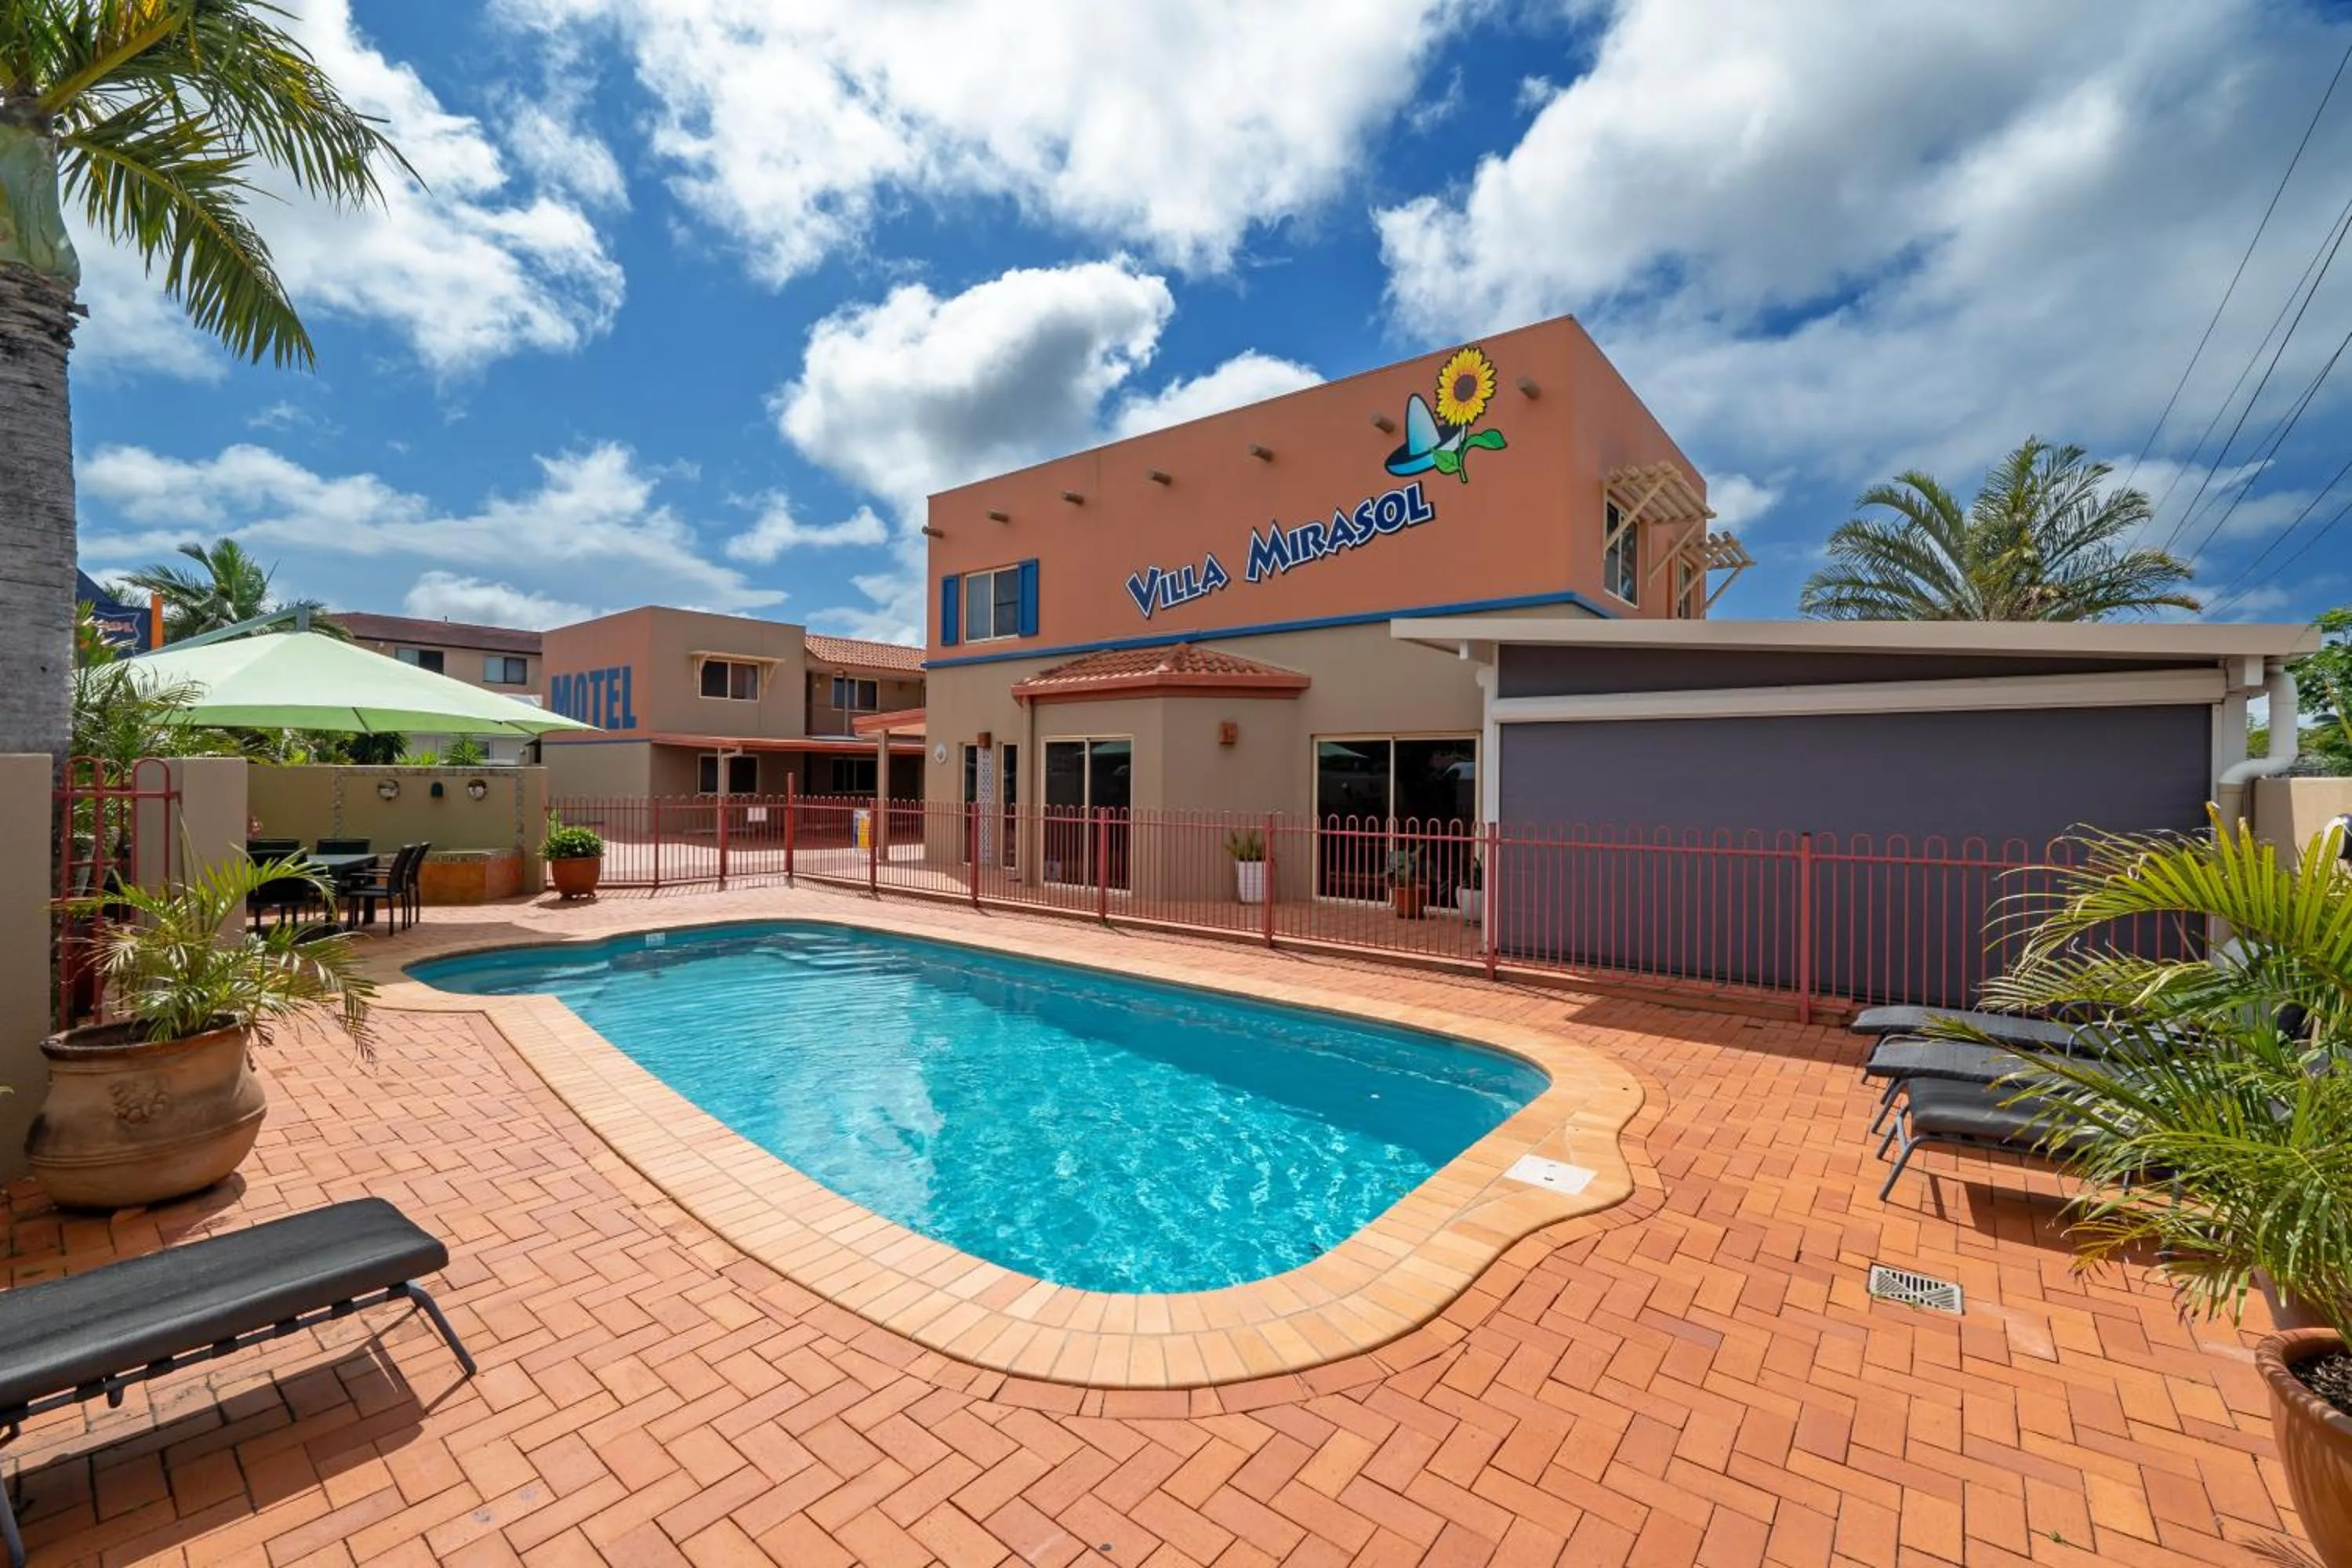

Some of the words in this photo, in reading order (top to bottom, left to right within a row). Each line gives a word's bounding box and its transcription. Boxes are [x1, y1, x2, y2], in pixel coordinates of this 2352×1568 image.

[1126, 554, 1229, 618] VILLA
[1246, 481, 1434, 583] MIRASOL
[551, 666, 637, 729] MOTEL
